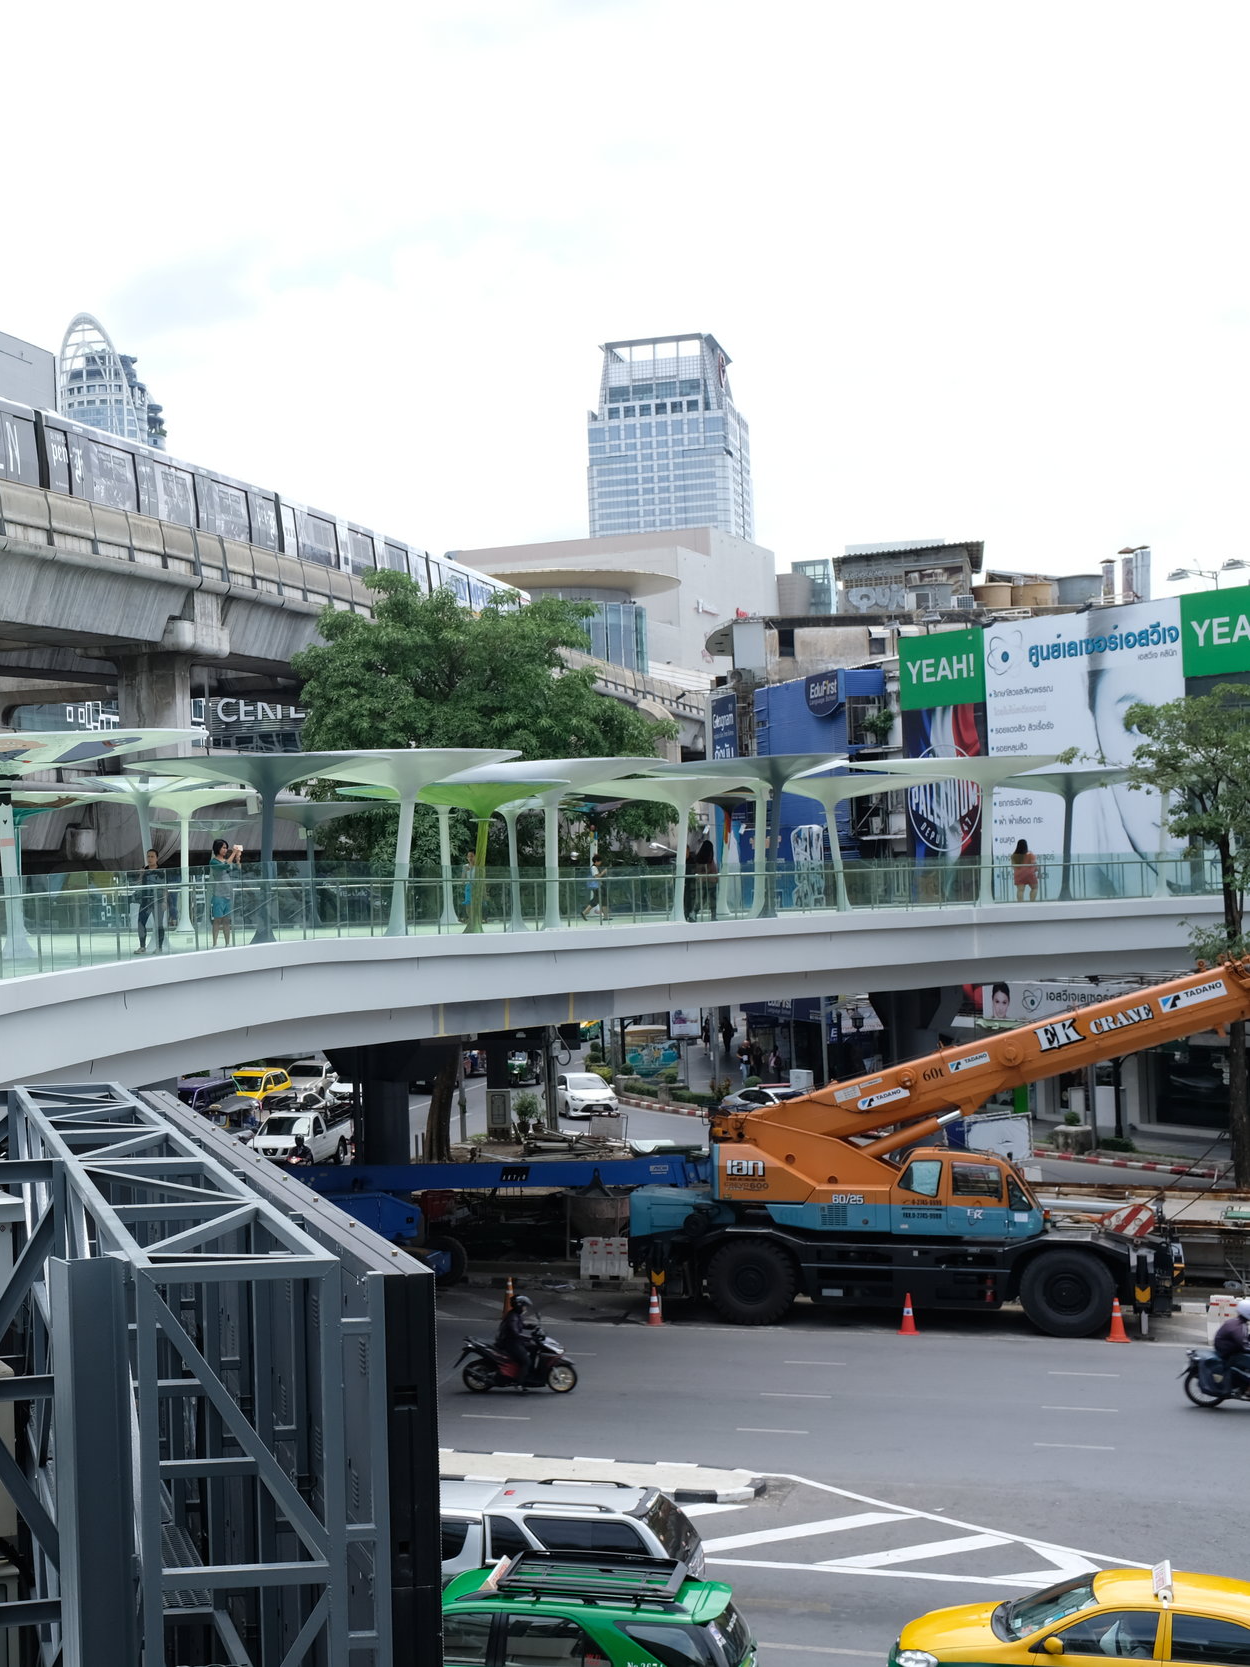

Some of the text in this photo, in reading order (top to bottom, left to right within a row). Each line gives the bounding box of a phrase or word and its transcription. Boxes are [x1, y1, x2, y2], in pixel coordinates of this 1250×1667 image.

[1028, 621, 1180, 668] ศูนย์เลเซอร์เอสวีเจ
[906, 653, 975, 685] YEAH!
[809, 678, 838, 699] EduFirst
[1183, 981, 1222, 998] TADANO
[1034, 1003, 1154, 1053] EK CRANE
[964, 1053, 987, 1065] TADANO
[922, 1067, 945, 1083] 60t
[876, 1088, 901, 1101] TADANO
[832, 1193, 865, 1205] 60/25
